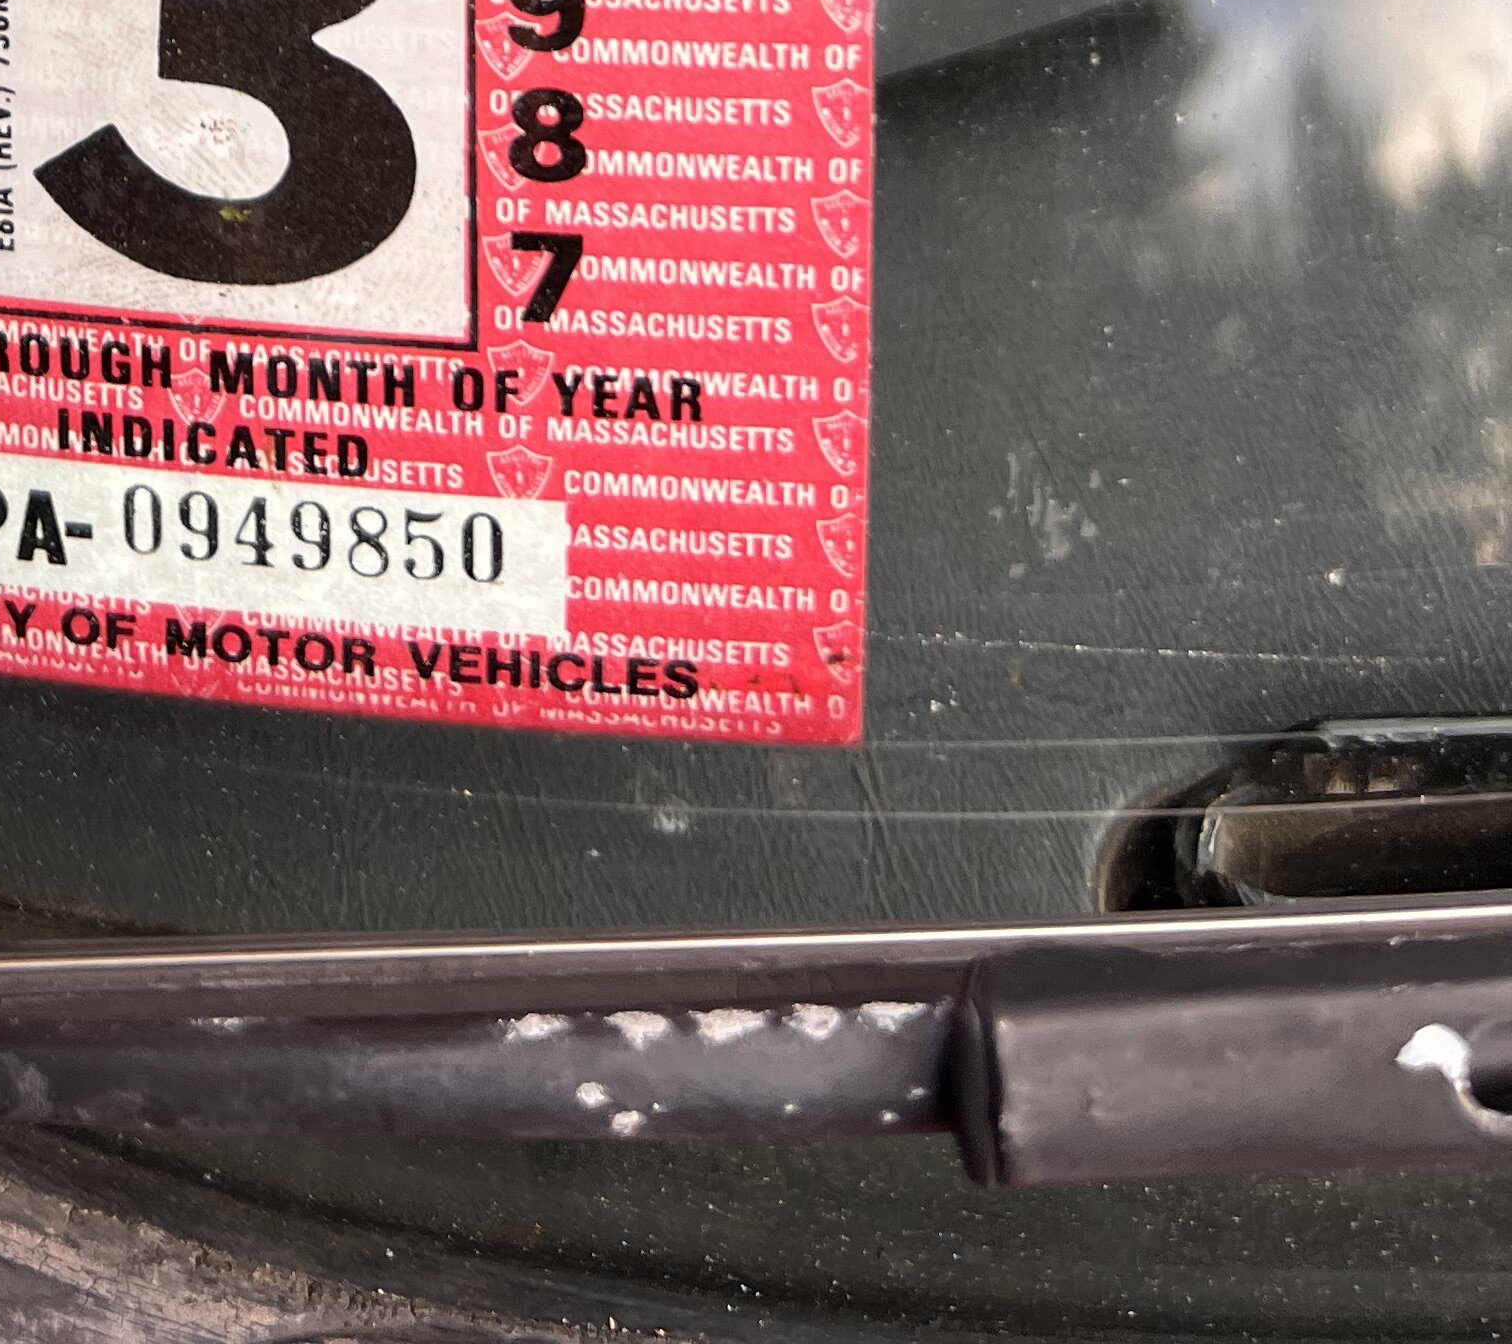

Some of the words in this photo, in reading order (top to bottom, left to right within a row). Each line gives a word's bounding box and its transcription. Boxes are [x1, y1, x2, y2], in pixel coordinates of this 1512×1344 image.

[825, 46, 861, 71] OF
[828, 158, 862, 182] OF
[496, 197, 531, 222] OF
[545, 199, 795, 232] MASSACHUSETTS
[830, 266, 864, 293] OF
[210, 350, 416, 408] MONTH
[451, 367, 520, 414] OF
[552, 371, 703, 423] YEAR
[58, 408, 369, 478] INDICATED
[499, 414, 532, 439] OF
[547, 417, 794, 452] MASSACHUSETTS
[563, 470, 815, 506] COMMONWEALTH
[61, 607, 137, 649] OF
[164, 617, 377, 677] MOTOR
[407, 640, 699, 699] VEHICLES
